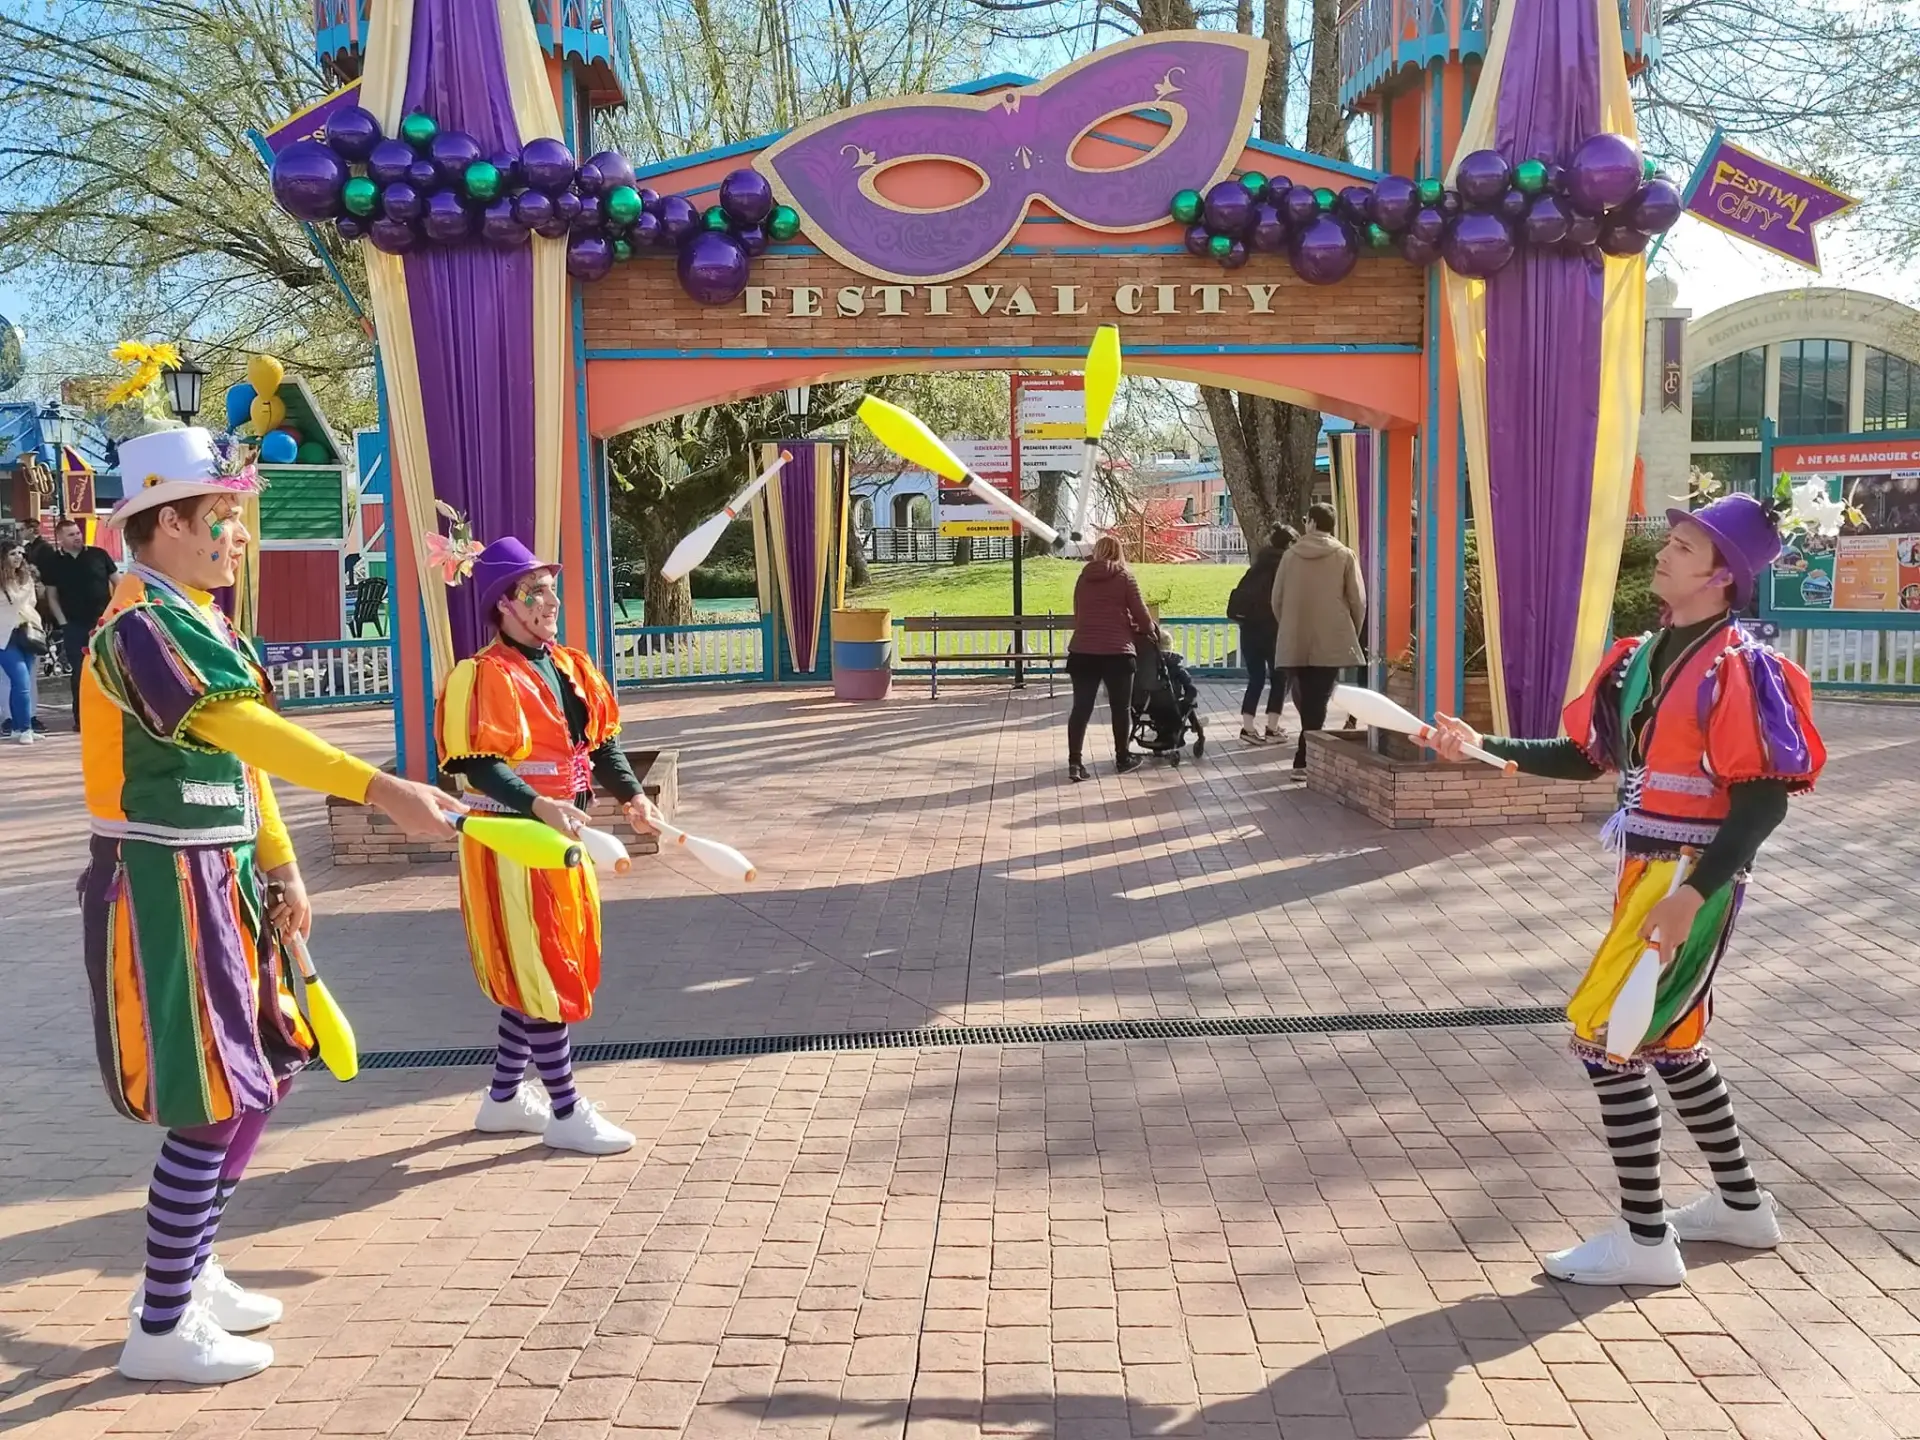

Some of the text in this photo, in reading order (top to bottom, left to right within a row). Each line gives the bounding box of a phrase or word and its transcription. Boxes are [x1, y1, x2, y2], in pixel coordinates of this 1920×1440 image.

[1708, 160, 1809, 234] FESTIVAL
[1717, 192, 1783, 231] CITY
[739, 283, 1281, 318] FESTIVAL CITY
[1796, 453, 1805, 466] À
[1807, 455, 1823, 465] NE
[1825, 454, 1846, 464] PAS
[1849, 451, 1908, 463] MANQUER
